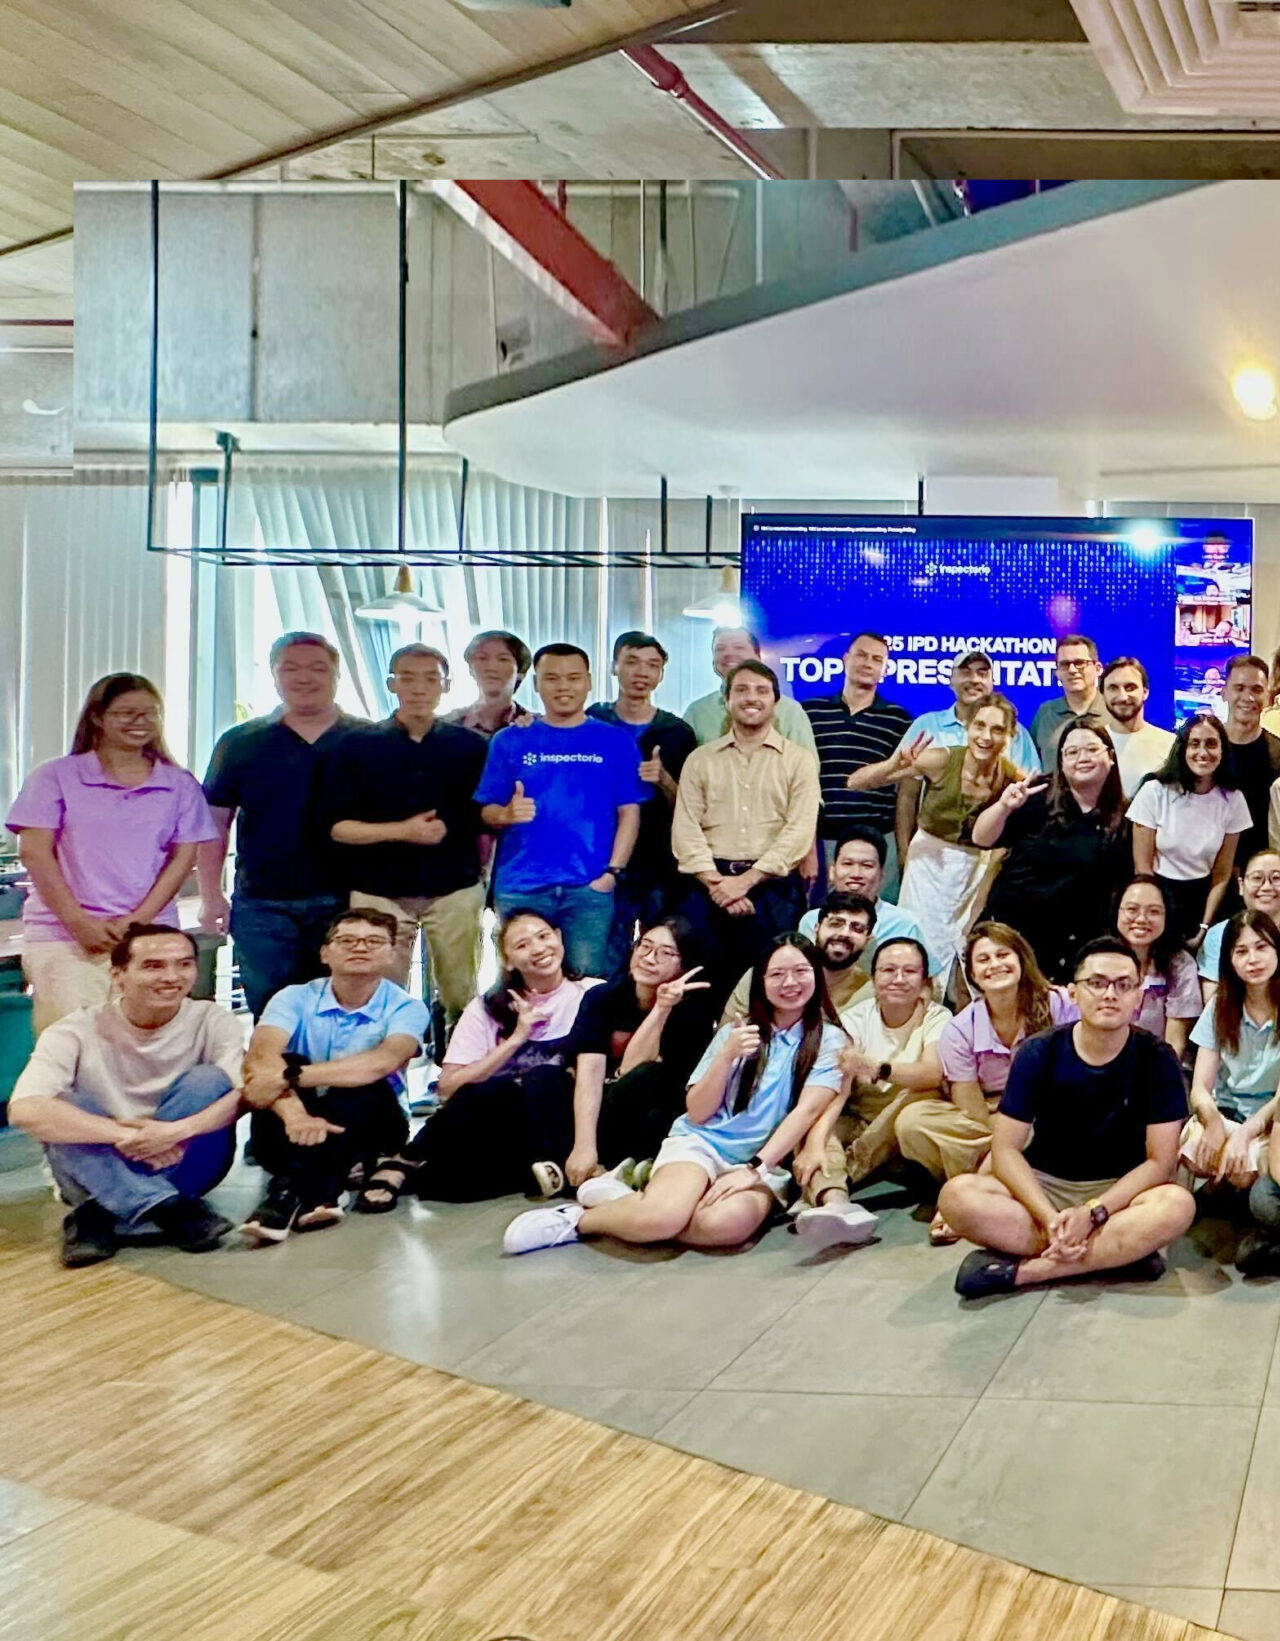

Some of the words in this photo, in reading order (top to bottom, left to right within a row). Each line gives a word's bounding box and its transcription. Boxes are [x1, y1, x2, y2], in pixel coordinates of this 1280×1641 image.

[907, 636, 939, 652] IPD
[941, 636, 1057, 654] HACKATHON
[780, 657, 844, 683] TOP
